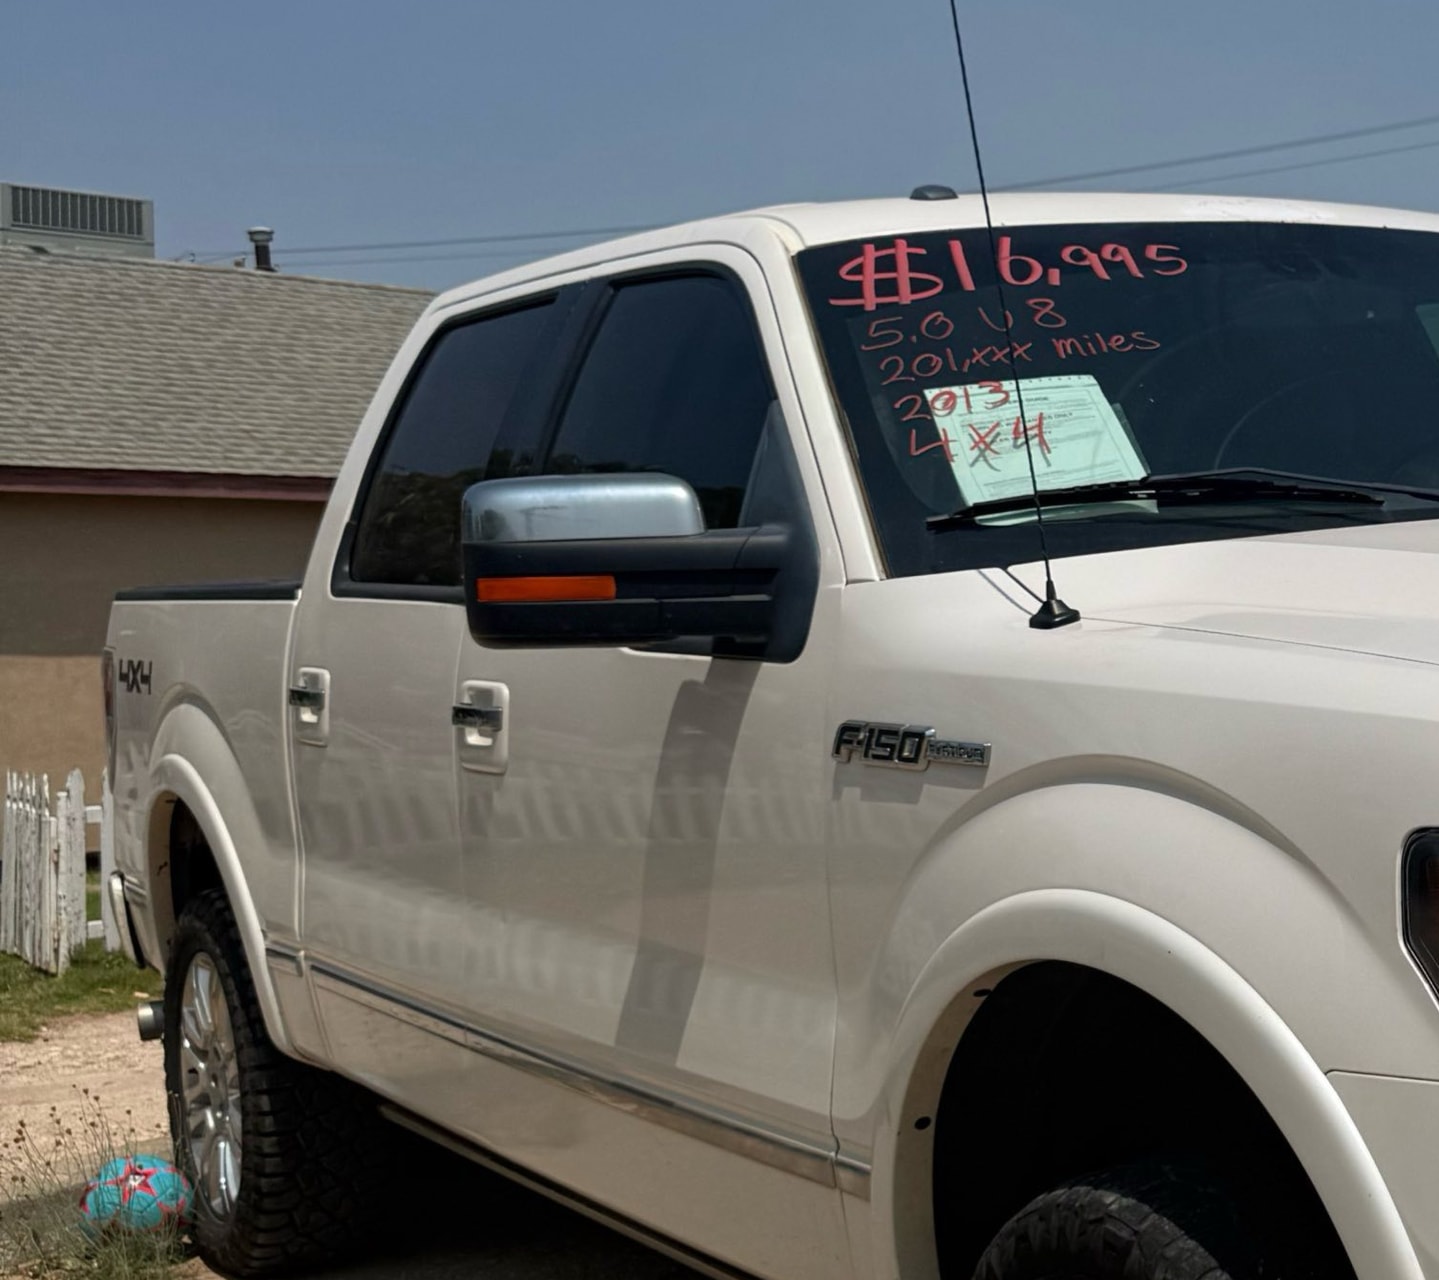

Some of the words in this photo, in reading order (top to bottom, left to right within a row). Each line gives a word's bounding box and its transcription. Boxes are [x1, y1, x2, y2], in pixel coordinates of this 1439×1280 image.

[828, 235, 1188, 311] $16,995
[861, 311, 955, 351] 5.0
[1051, 330, 1161, 360] miles
[894, 381, 1011, 421] 2013
